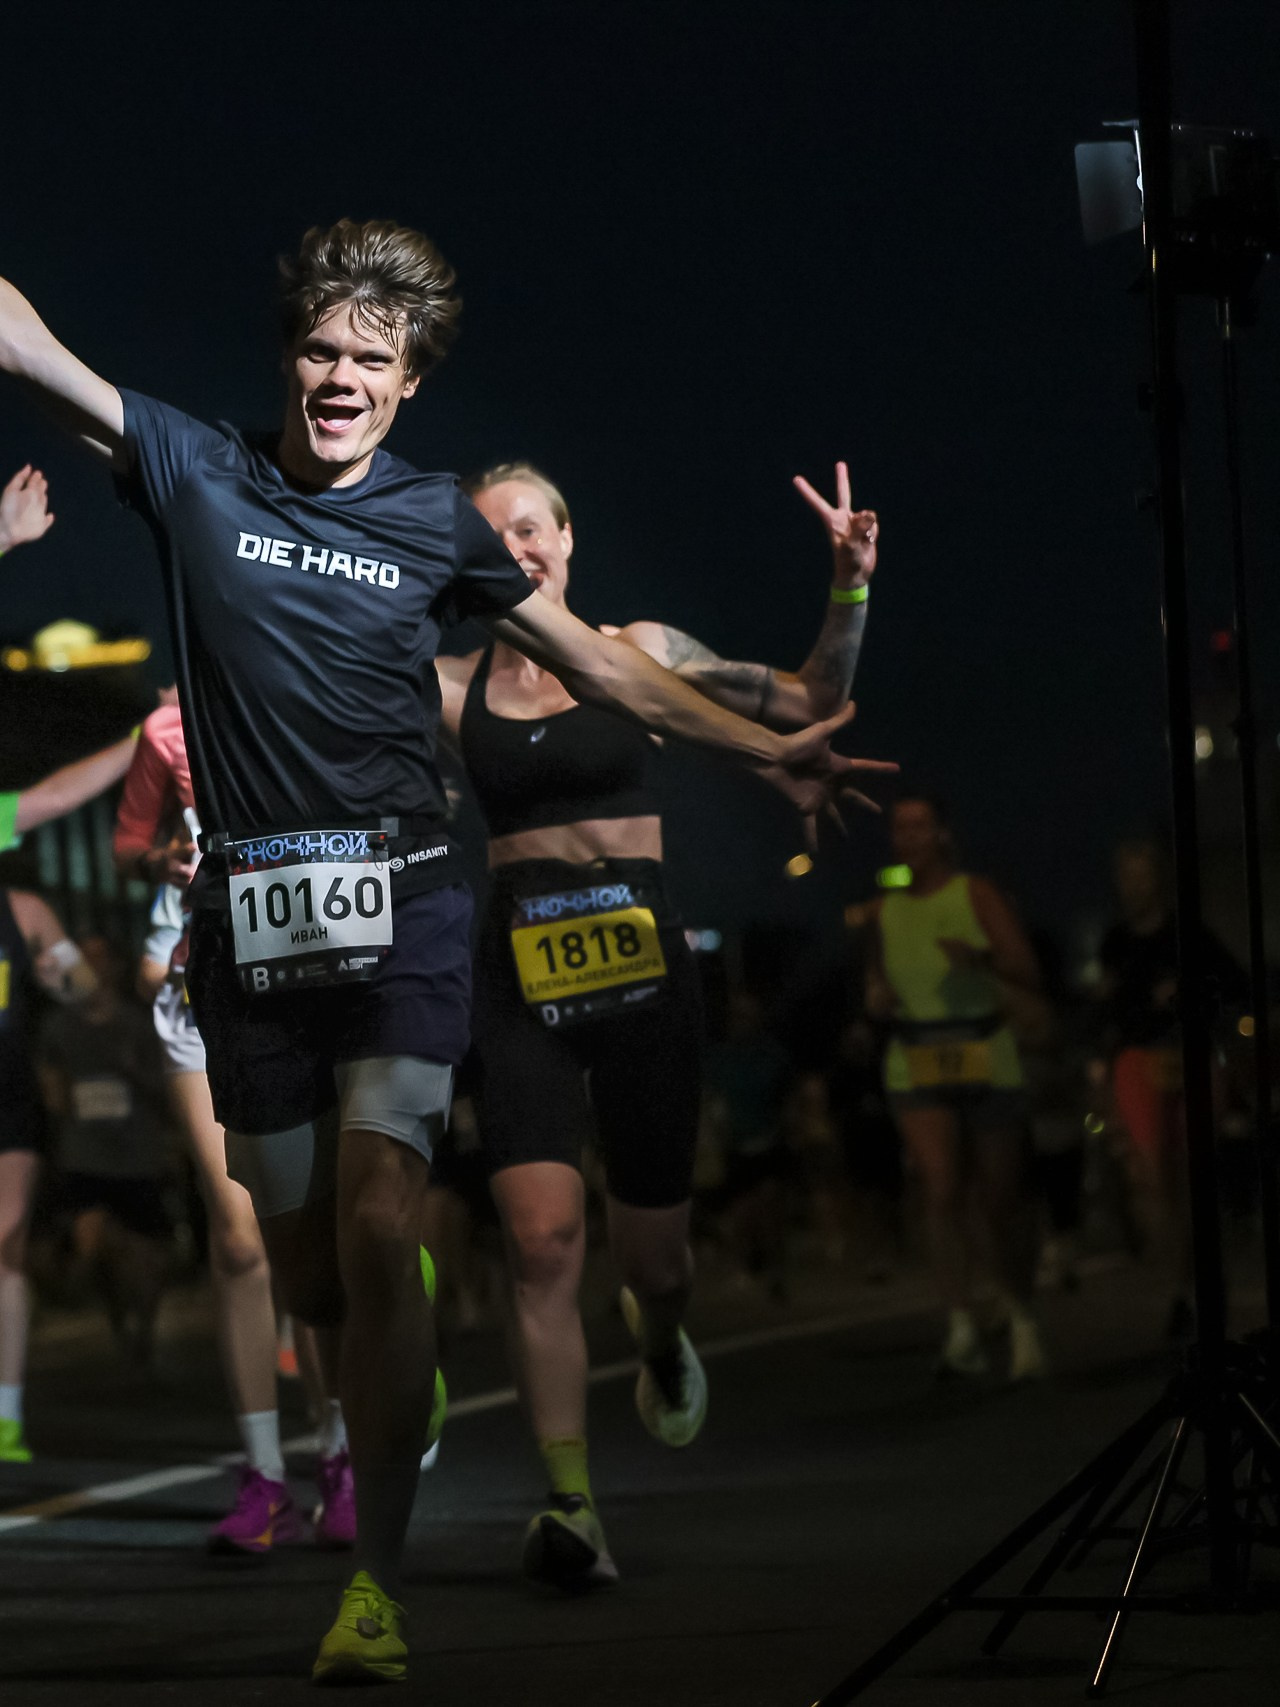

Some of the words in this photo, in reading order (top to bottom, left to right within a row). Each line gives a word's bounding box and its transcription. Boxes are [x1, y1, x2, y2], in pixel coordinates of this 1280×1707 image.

[236, 531, 297, 568] DIE
[300, 544, 400, 590] HARD
[407, 845, 448, 864] INSANITY
[238, 876, 384, 933] 10160
[290, 926, 329, 945] ИВАН
[536, 923, 641, 973] 1818
